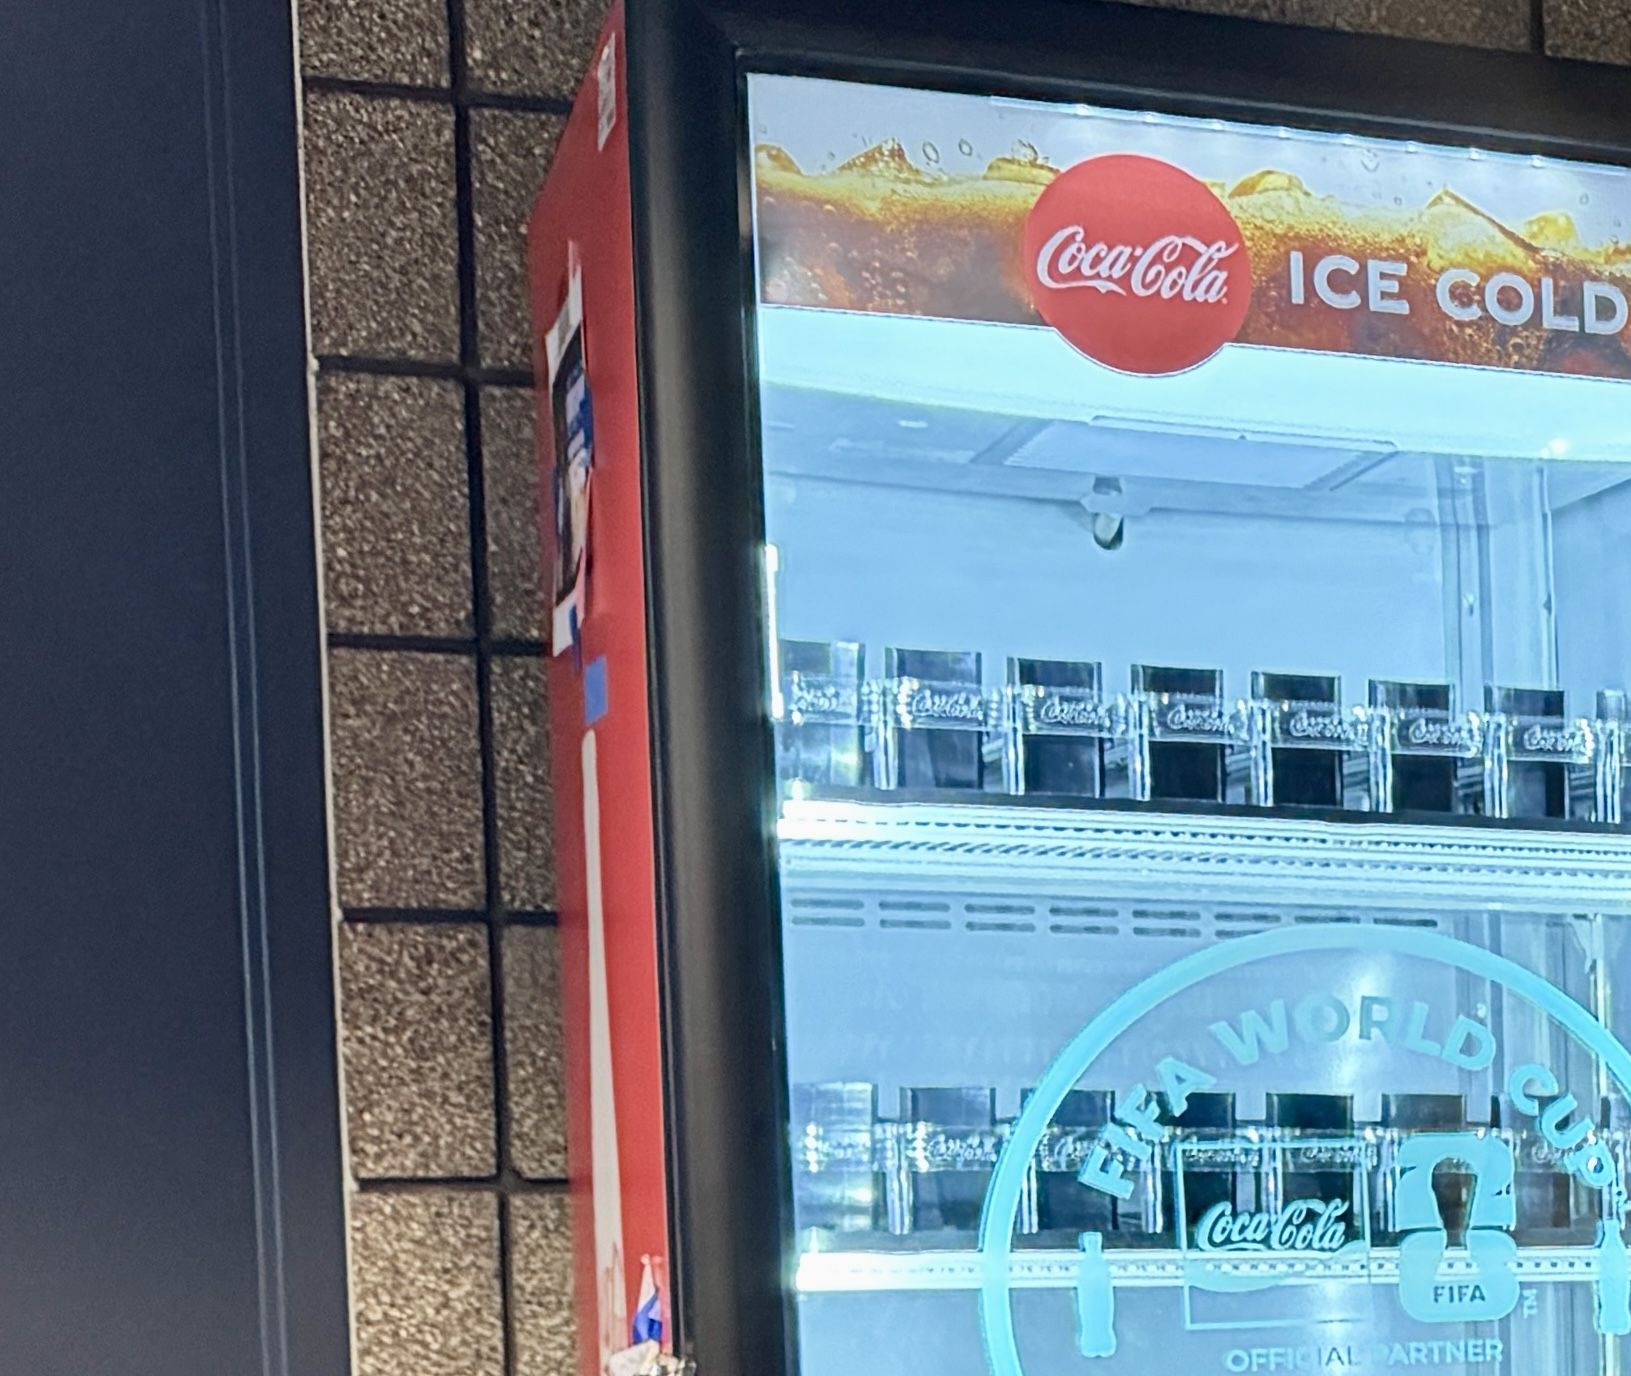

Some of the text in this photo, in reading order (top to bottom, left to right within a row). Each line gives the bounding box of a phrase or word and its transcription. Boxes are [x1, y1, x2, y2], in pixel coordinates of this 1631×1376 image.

[1036, 224, 1239, 305] Coca-Cola
[1288, 250, 1630, 337] ICE COLD
[1076, 1053, 1217, 1201] FIFA
[1207, 995, 1497, 1071] WORLD
[1508, 1061, 1614, 1190] CUP
[1432, 1282, 1487, 1306] FIFA
[1225, 1337, 1504, 1373] OFFICIAL PARTNER
